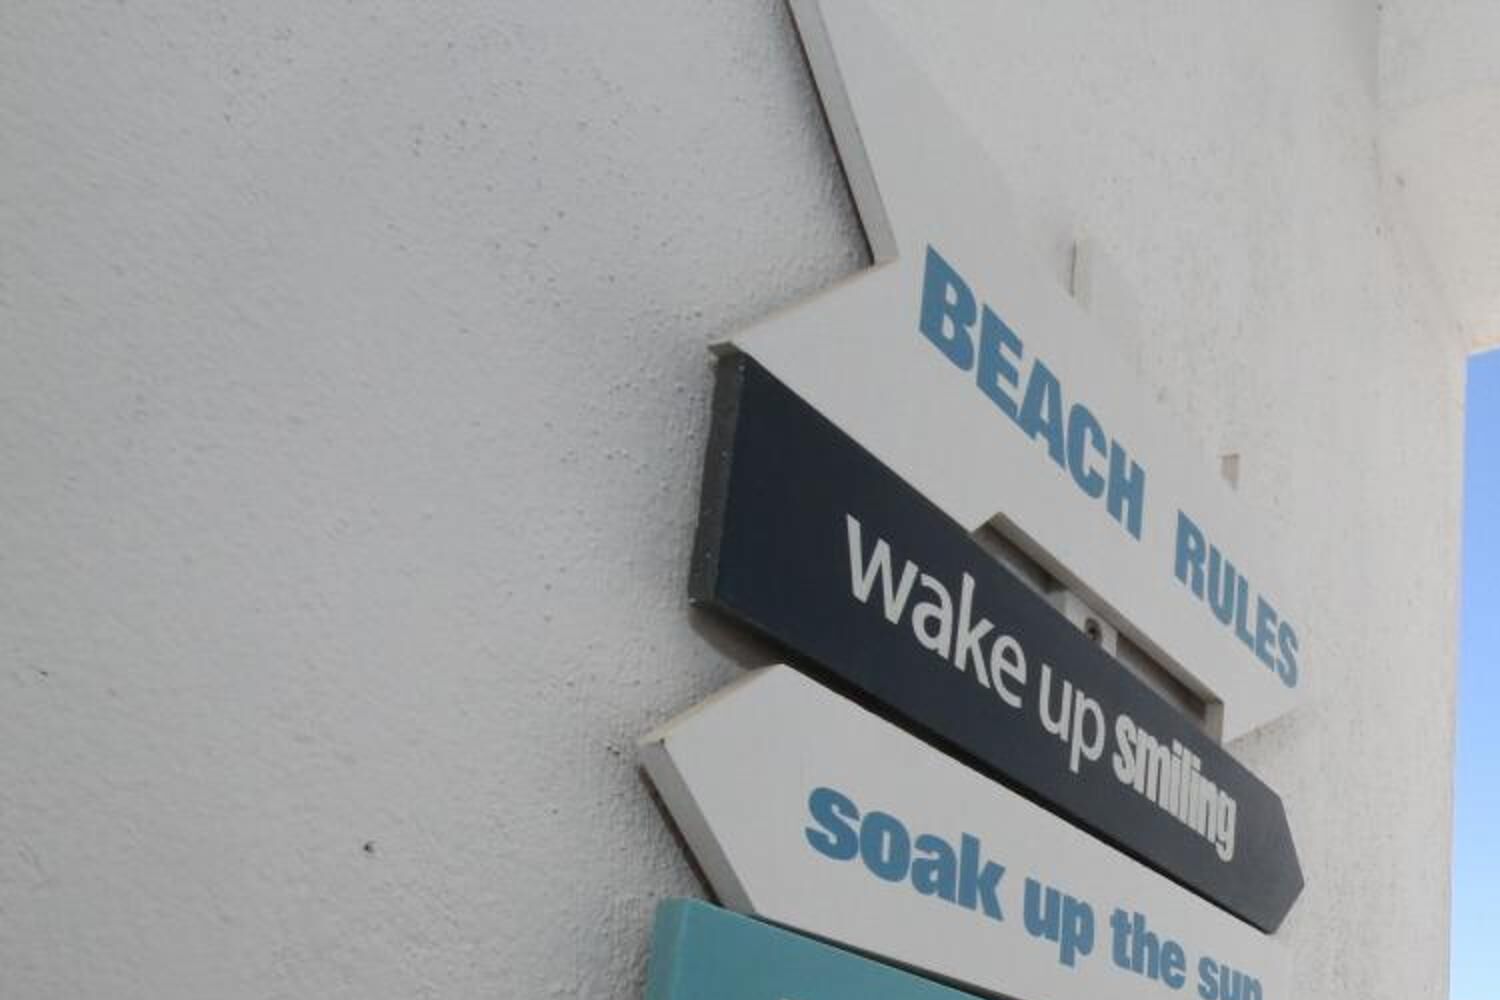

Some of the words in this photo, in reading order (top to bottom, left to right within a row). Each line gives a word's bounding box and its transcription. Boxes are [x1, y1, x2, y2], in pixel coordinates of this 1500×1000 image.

[918, 243, 1146, 542] BEACH
[1173, 508, 1297, 689] RULES
[845, 512, 1028, 708] wake
[1038, 664, 1105, 773] up
[1112, 714, 1237, 862] smiling
[804, 787, 1004, 922] soak
[1022, 876, 1095, 967] up
[1109, 905, 1186, 990] the
